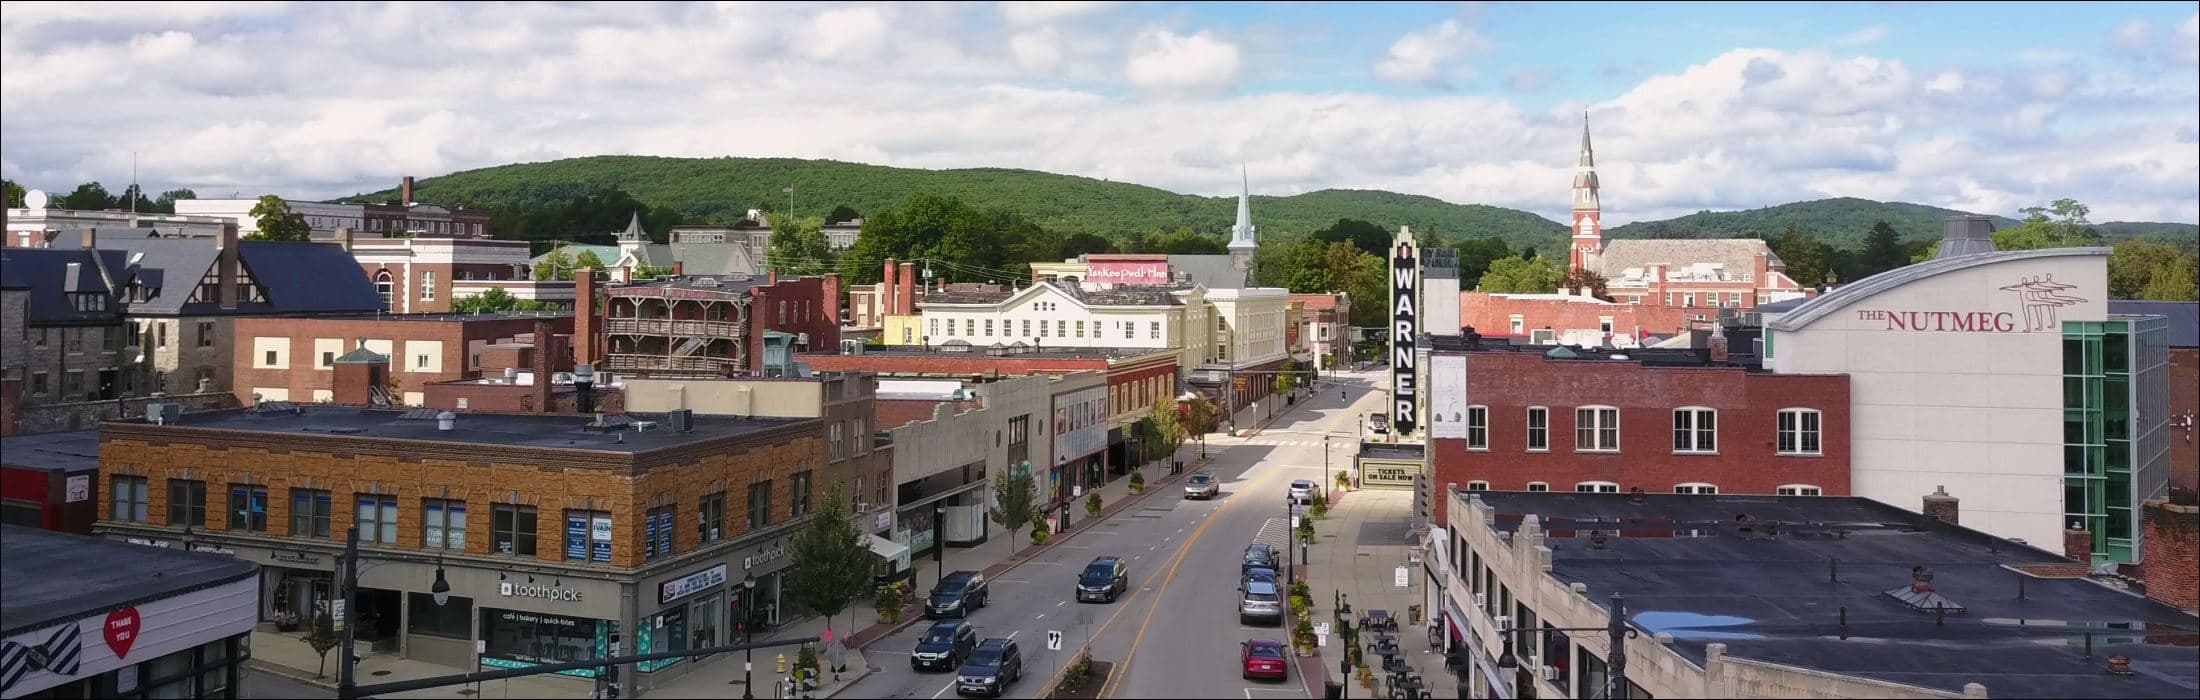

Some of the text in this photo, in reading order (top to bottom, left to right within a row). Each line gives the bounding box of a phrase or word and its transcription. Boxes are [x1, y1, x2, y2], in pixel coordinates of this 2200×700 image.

[1857, 310, 2015, 333] THE NUTMEG
[1395, 268, 1414, 422] WARNER
[752, 543, 785, 567] toothpick
[515, 582, 578, 603] toothpick
[111, 616, 132, 629] THANK
[520, 614, 538, 623] bakery
[116, 630, 130, 642] YOU
